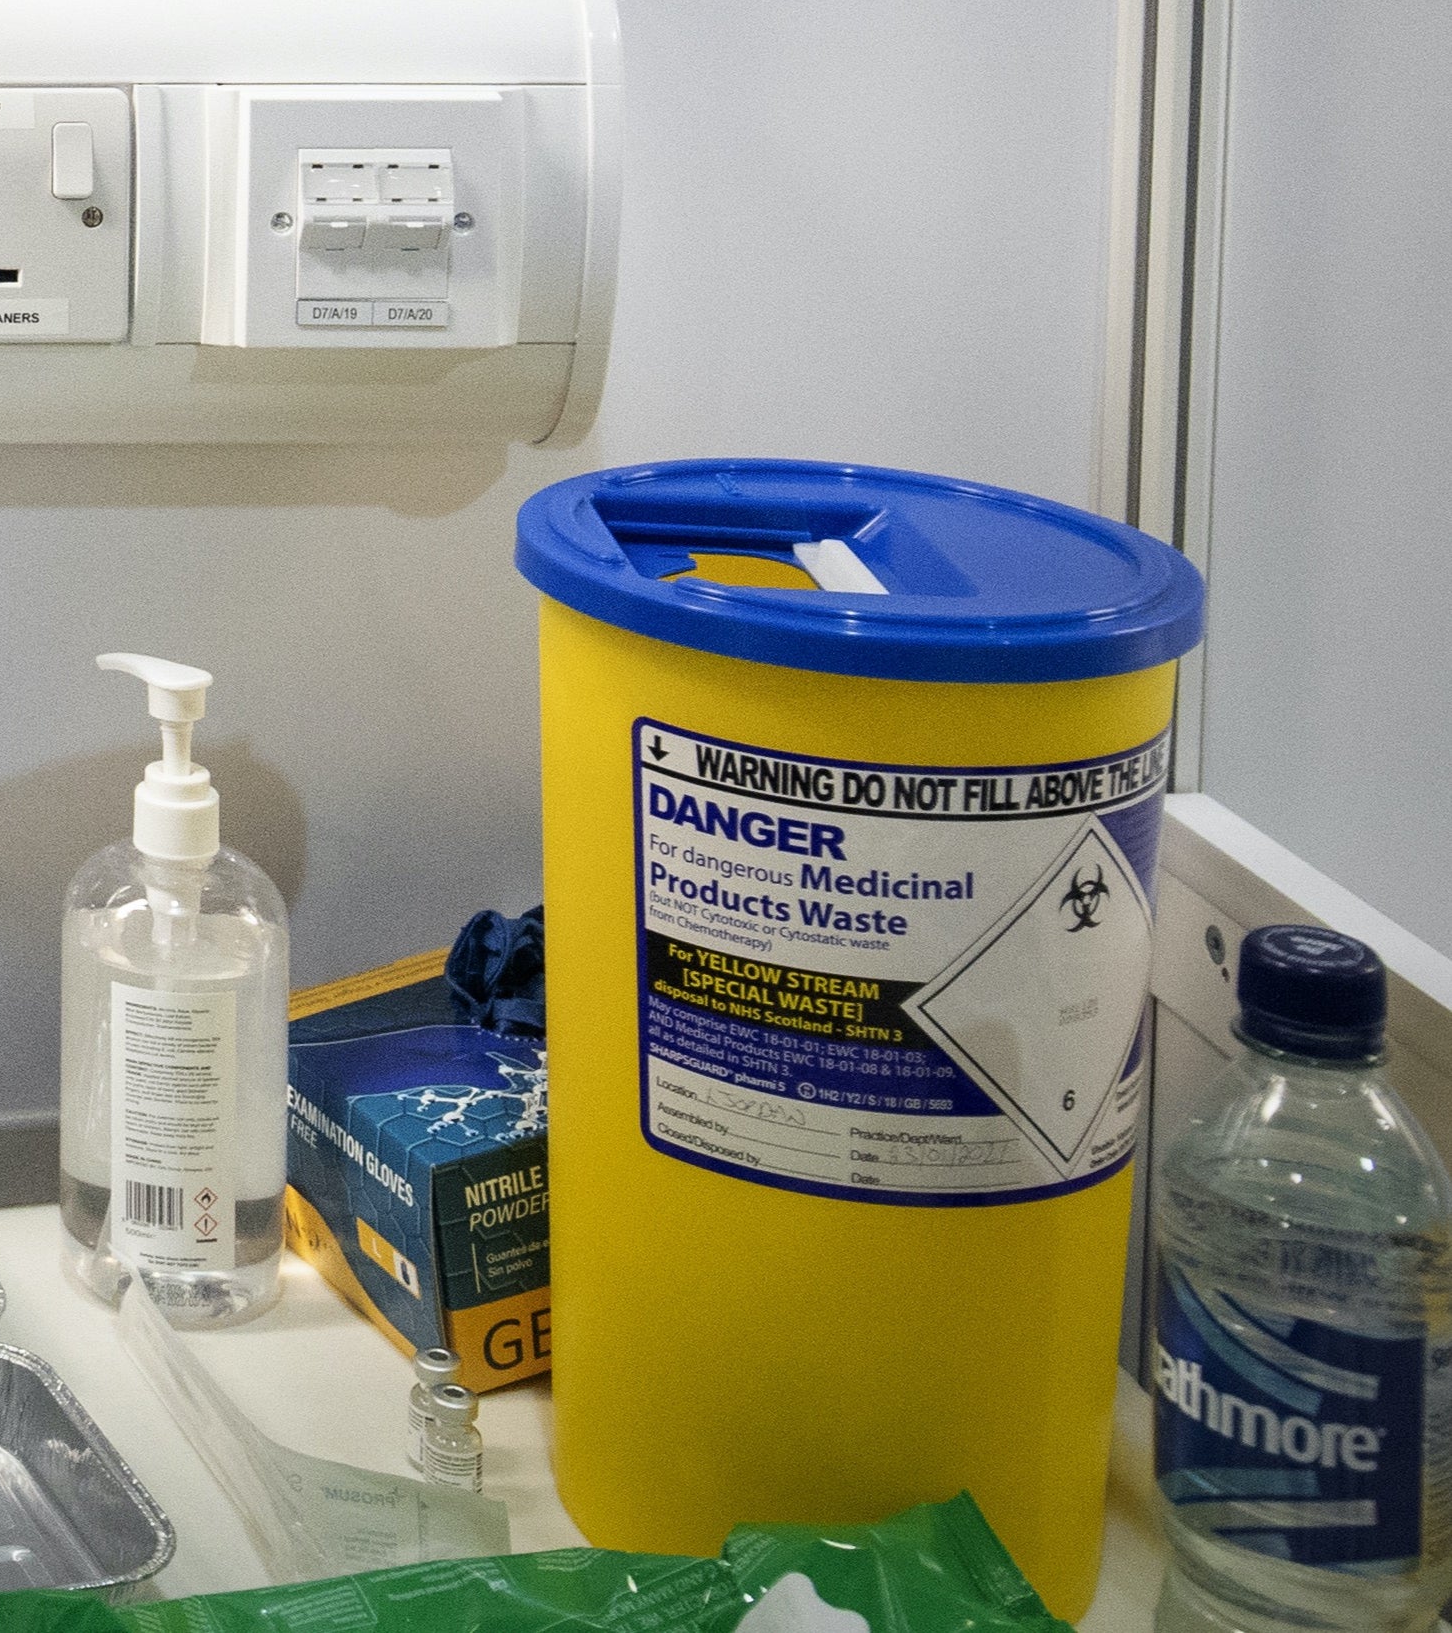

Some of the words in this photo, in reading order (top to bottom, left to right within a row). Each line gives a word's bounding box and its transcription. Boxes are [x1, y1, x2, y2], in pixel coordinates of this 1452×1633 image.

[311, 306, 359, 321] D7/A/19
[387, 307, 434, 321] D7/A/20
[695, 743, 834, 802] WARNING
[843, 771, 886, 808] DO
[894, 776, 957, 811] NOT
[964, 778, 1020, 812] FILL
[1025, 767, 1104, 809] ABOVE
[1108, 755, 1141, 797] THE
[650, 782, 847, 861] DANGER
[650, 833, 678, 858] For
[683, 846, 793, 887] dangerous
[800, 863, 973, 900] Medicinal
[650, 890, 671, 907] (but
[674, 900, 698, 916] NOT
[701, 908, 759, 933] Cytotoxic
[762, 925, 776, 936] or
[779, 926, 846, 948] Cytostatic
[849, 938, 890, 951] waste
[651, 861, 790, 922] Products
[798, 898, 907, 935] Waste
[649, 905, 675, 924] from
[677, 916, 772, 952] Chemotherapy)
[668, 943, 694, 964] For
[697, 949, 782, 985] YELLOW
[787, 971, 879, 1001] STREAM
[683, 968, 773, 1005] [SPECIAL
[778, 990, 863, 1022] WASTE]
[648, 995, 672, 1015] May
[672, 1008, 727, 1033] comprise
[729, 1023, 760, 1041] EWC
[827, 1044, 860, 1059] EWC
[654, 979, 709, 1007] disposal
[711, 997, 727, 1012] to
[730, 1002, 761, 1022] NHS
[764, 1010, 833, 1034] Scotland
[846, 1023, 890, 1041] SHTN
[893, 1030, 903, 1042] 3
[648, 1025, 661, 1037] all
[663, 1031, 675, 1043] as
[677, 1036, 725, 1060] detailed
[727, 1053, 740, 1064] in
[742, 1056, 778, 1074] SHTN
[649, 1010, 673, 1028] AND
[675, 1021, 721, 1045] Medical
[724, 1036, 780, 1060] Products
[783, 1050, 815, 1067] EWC
[881, 1064, 892, 1076] &
[1062, 1089, 1075, 1111] 6
[287, 1084, 363, 1166] EXAMINATION
[366, 1151, 414, 1207] GLOVES
[291, 1115, 319, 1149] FREE
[850, 1150, 879, 1163] Date
[464, 1165, 544, 1209] NITRILE
[851, 1172, 880, 1185] Date
[506, 1257, 534, 1275] polvo
